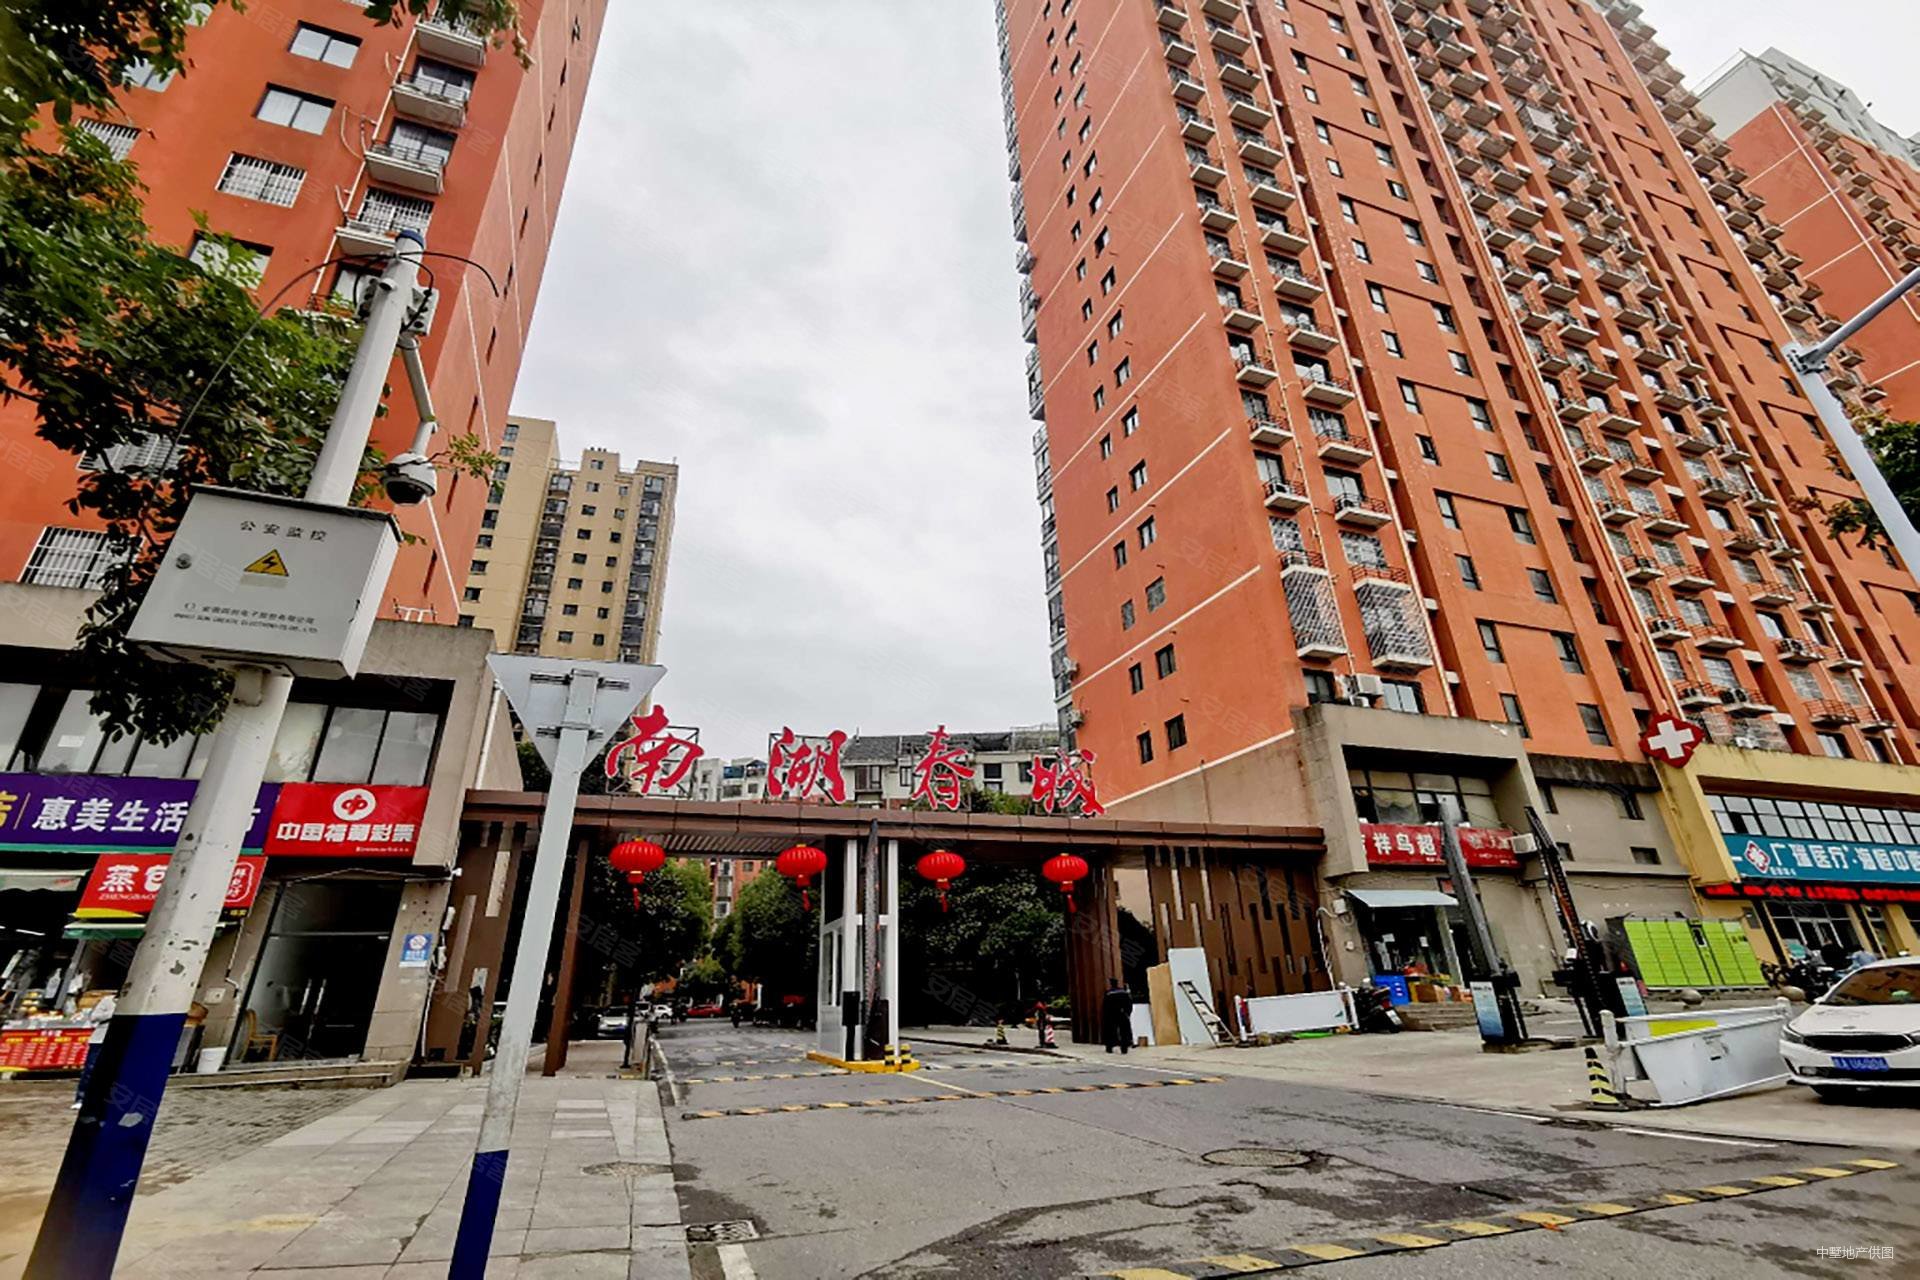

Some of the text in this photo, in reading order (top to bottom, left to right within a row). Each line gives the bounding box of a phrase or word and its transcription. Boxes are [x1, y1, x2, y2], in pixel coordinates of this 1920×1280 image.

[240, 520, 328, 542] 公安监控
[605, 704, 1106, 818] 南湖春城
[32, 797, 261, 834] 惠美生活
[275, 822, 415, 843] 中国福利彩票
